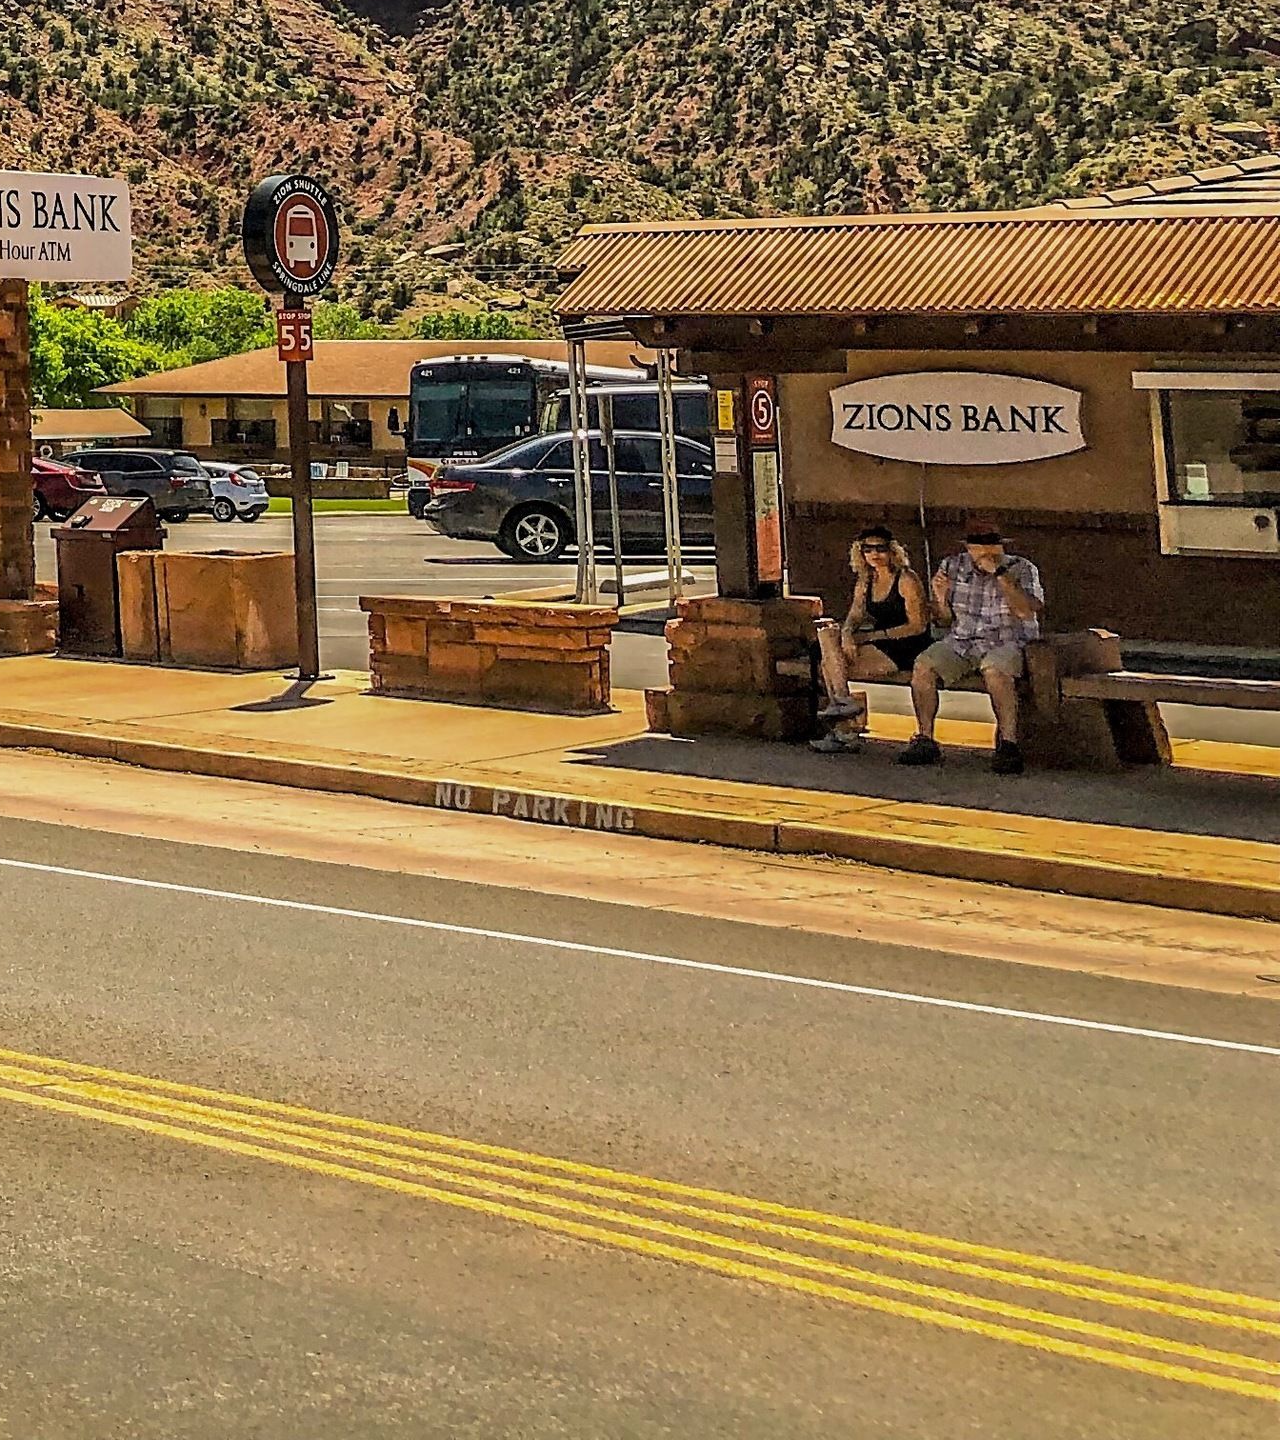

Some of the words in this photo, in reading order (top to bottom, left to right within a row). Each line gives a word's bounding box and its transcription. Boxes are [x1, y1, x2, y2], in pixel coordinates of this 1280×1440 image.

[273, 181, 292, 205] ZION
[294, 179, 328, 207] SHUTTLE
[31, 191, 120, 232] BANK
[0, 239, 35, 260] Hour
[38, 241, 72, 261] ATM
[272, 262, 318, 293] SPRINGDALE
[318, 262, 333, 284] LINE
[278, 312, 296, 320] STOP
[297, 312, 311, 320] STOP
[420, 369, 433, 377] 421
[507, 367, 521, 375] 421
[758, 397, 768, 424] 5
[843, 403, 952, 432] ZIONS
[960, 404, 1070, 434] BANK
[435, 783, 472, 810] NO
[491, 789, 635, 830] PARKING
